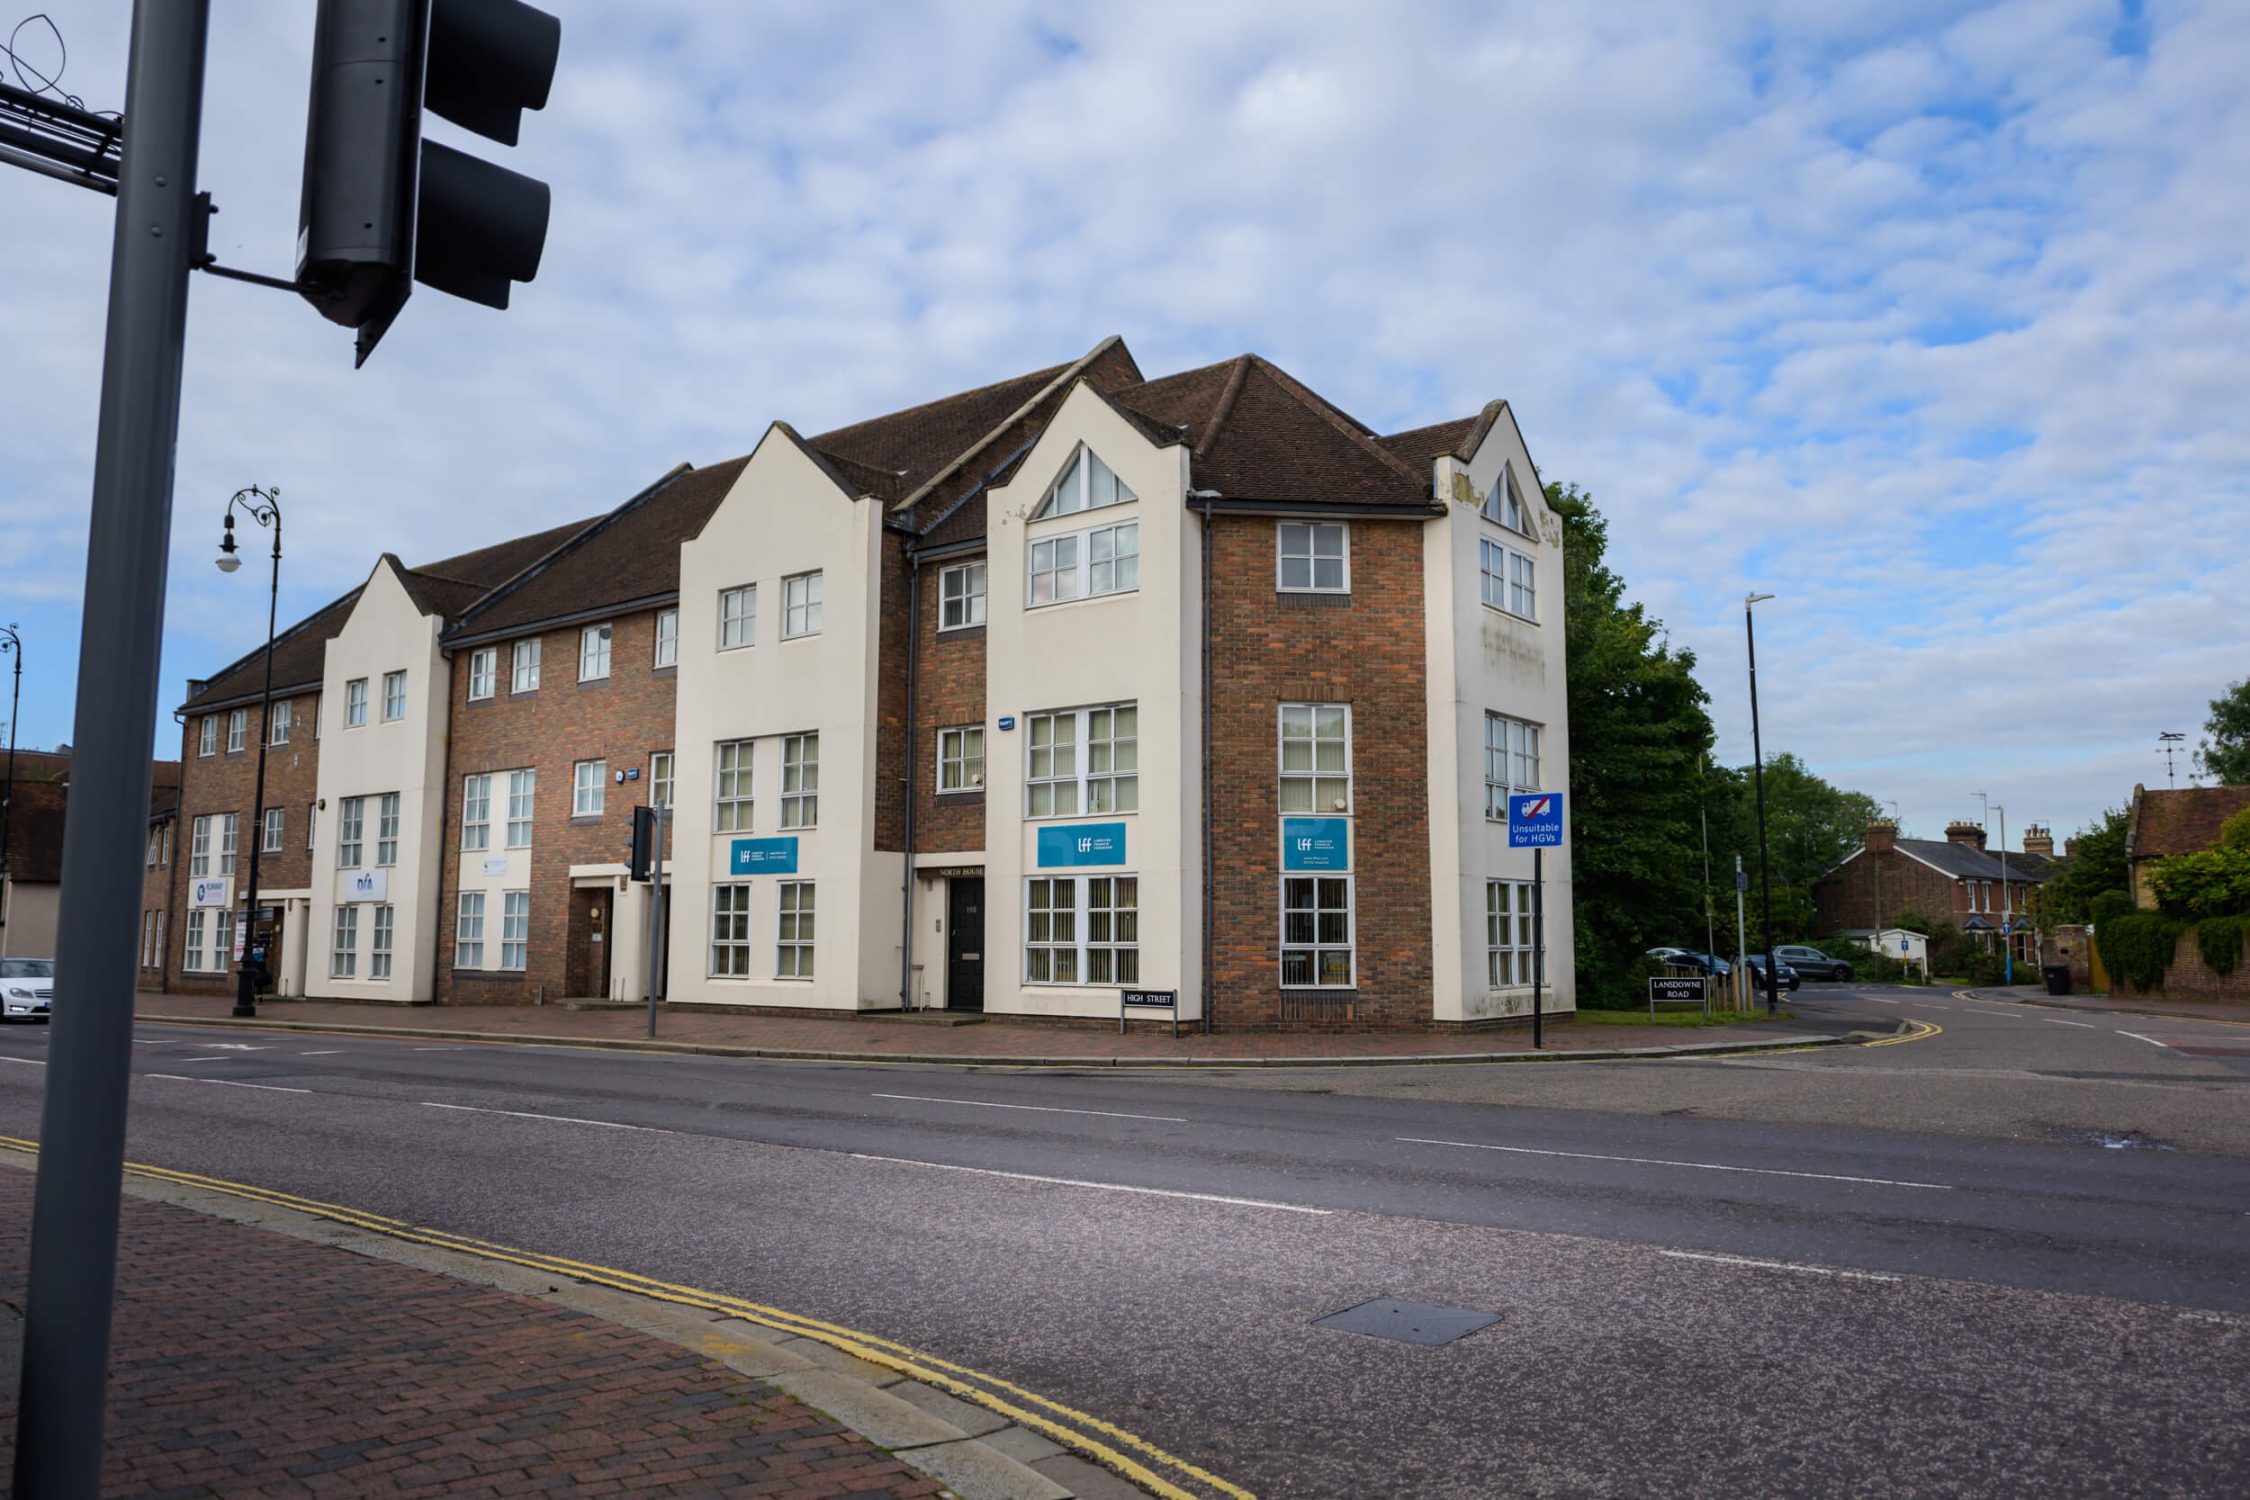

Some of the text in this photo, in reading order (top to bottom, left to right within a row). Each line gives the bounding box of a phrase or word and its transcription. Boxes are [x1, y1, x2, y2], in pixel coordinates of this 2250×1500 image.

[1512, 824, 1560, 833] Unsuitable
[1515, 834, 1556, 843] for HGVs
[940, 868, 961, 876] NORTH
[1653, 981, 1702, 989] LANSDOWNE
[1667, 990, 1690, 998] ROAD
[1127, 994, 1171, 1004] HIGH STREET
